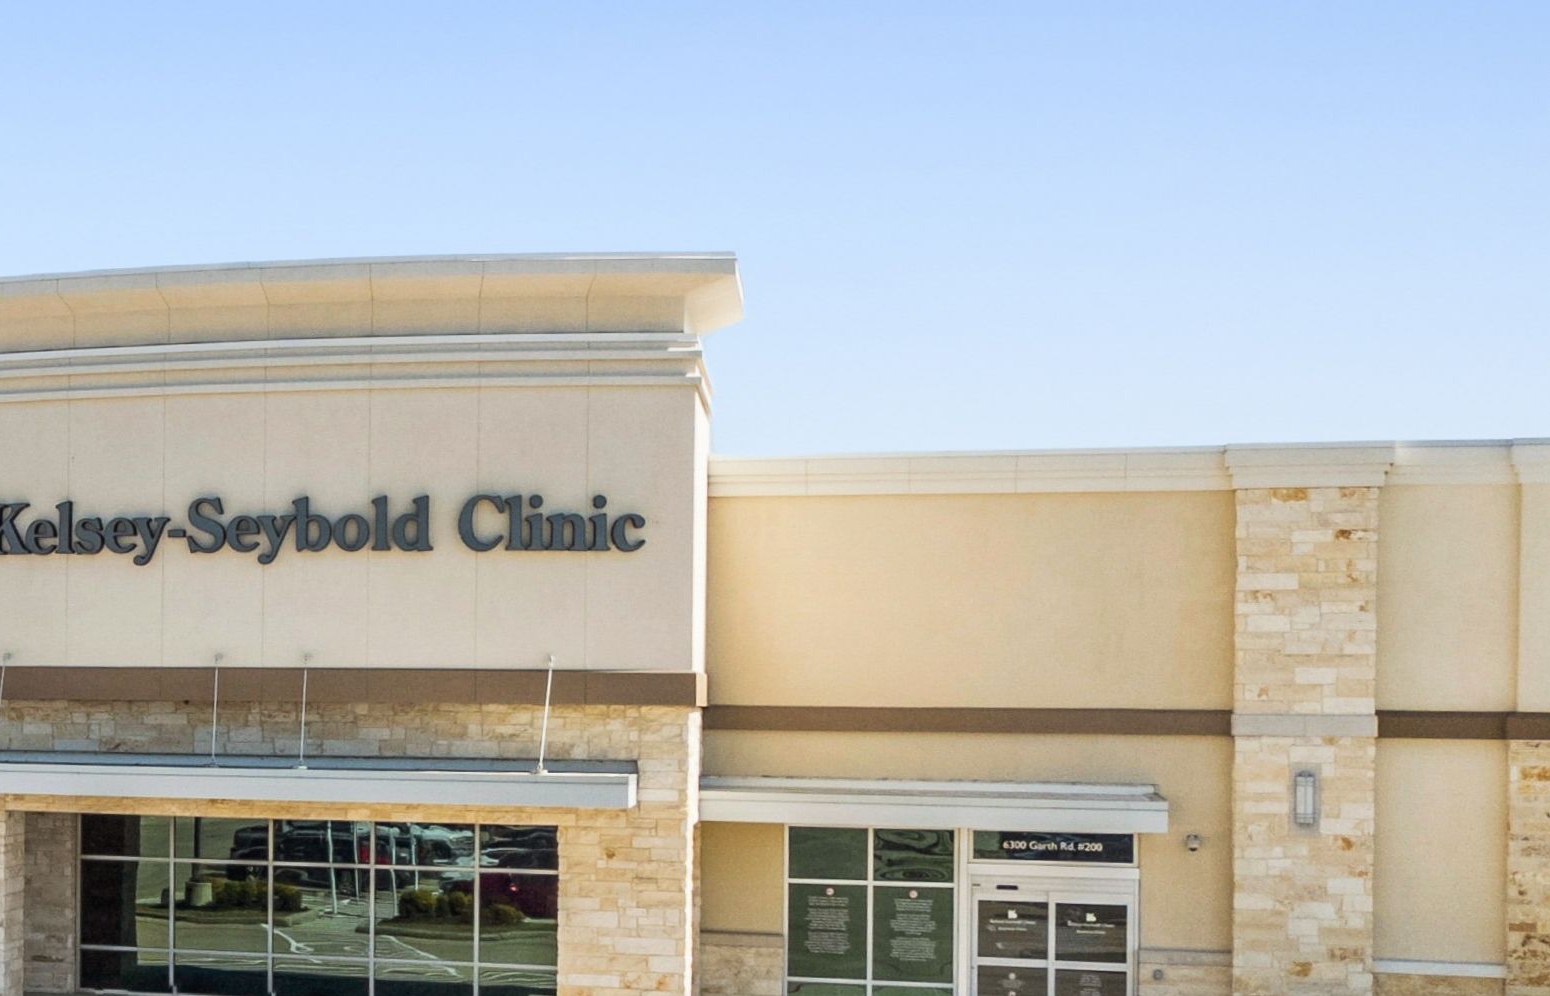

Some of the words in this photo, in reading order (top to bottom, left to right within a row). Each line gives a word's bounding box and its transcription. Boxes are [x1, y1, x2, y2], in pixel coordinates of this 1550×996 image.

[457, 494, 646, 553] Clinic
[1002, 840, 1027, 850] 6300
[1029, 841, 1058, 851] Garth
[1077, 842, 1103, 852] #200
